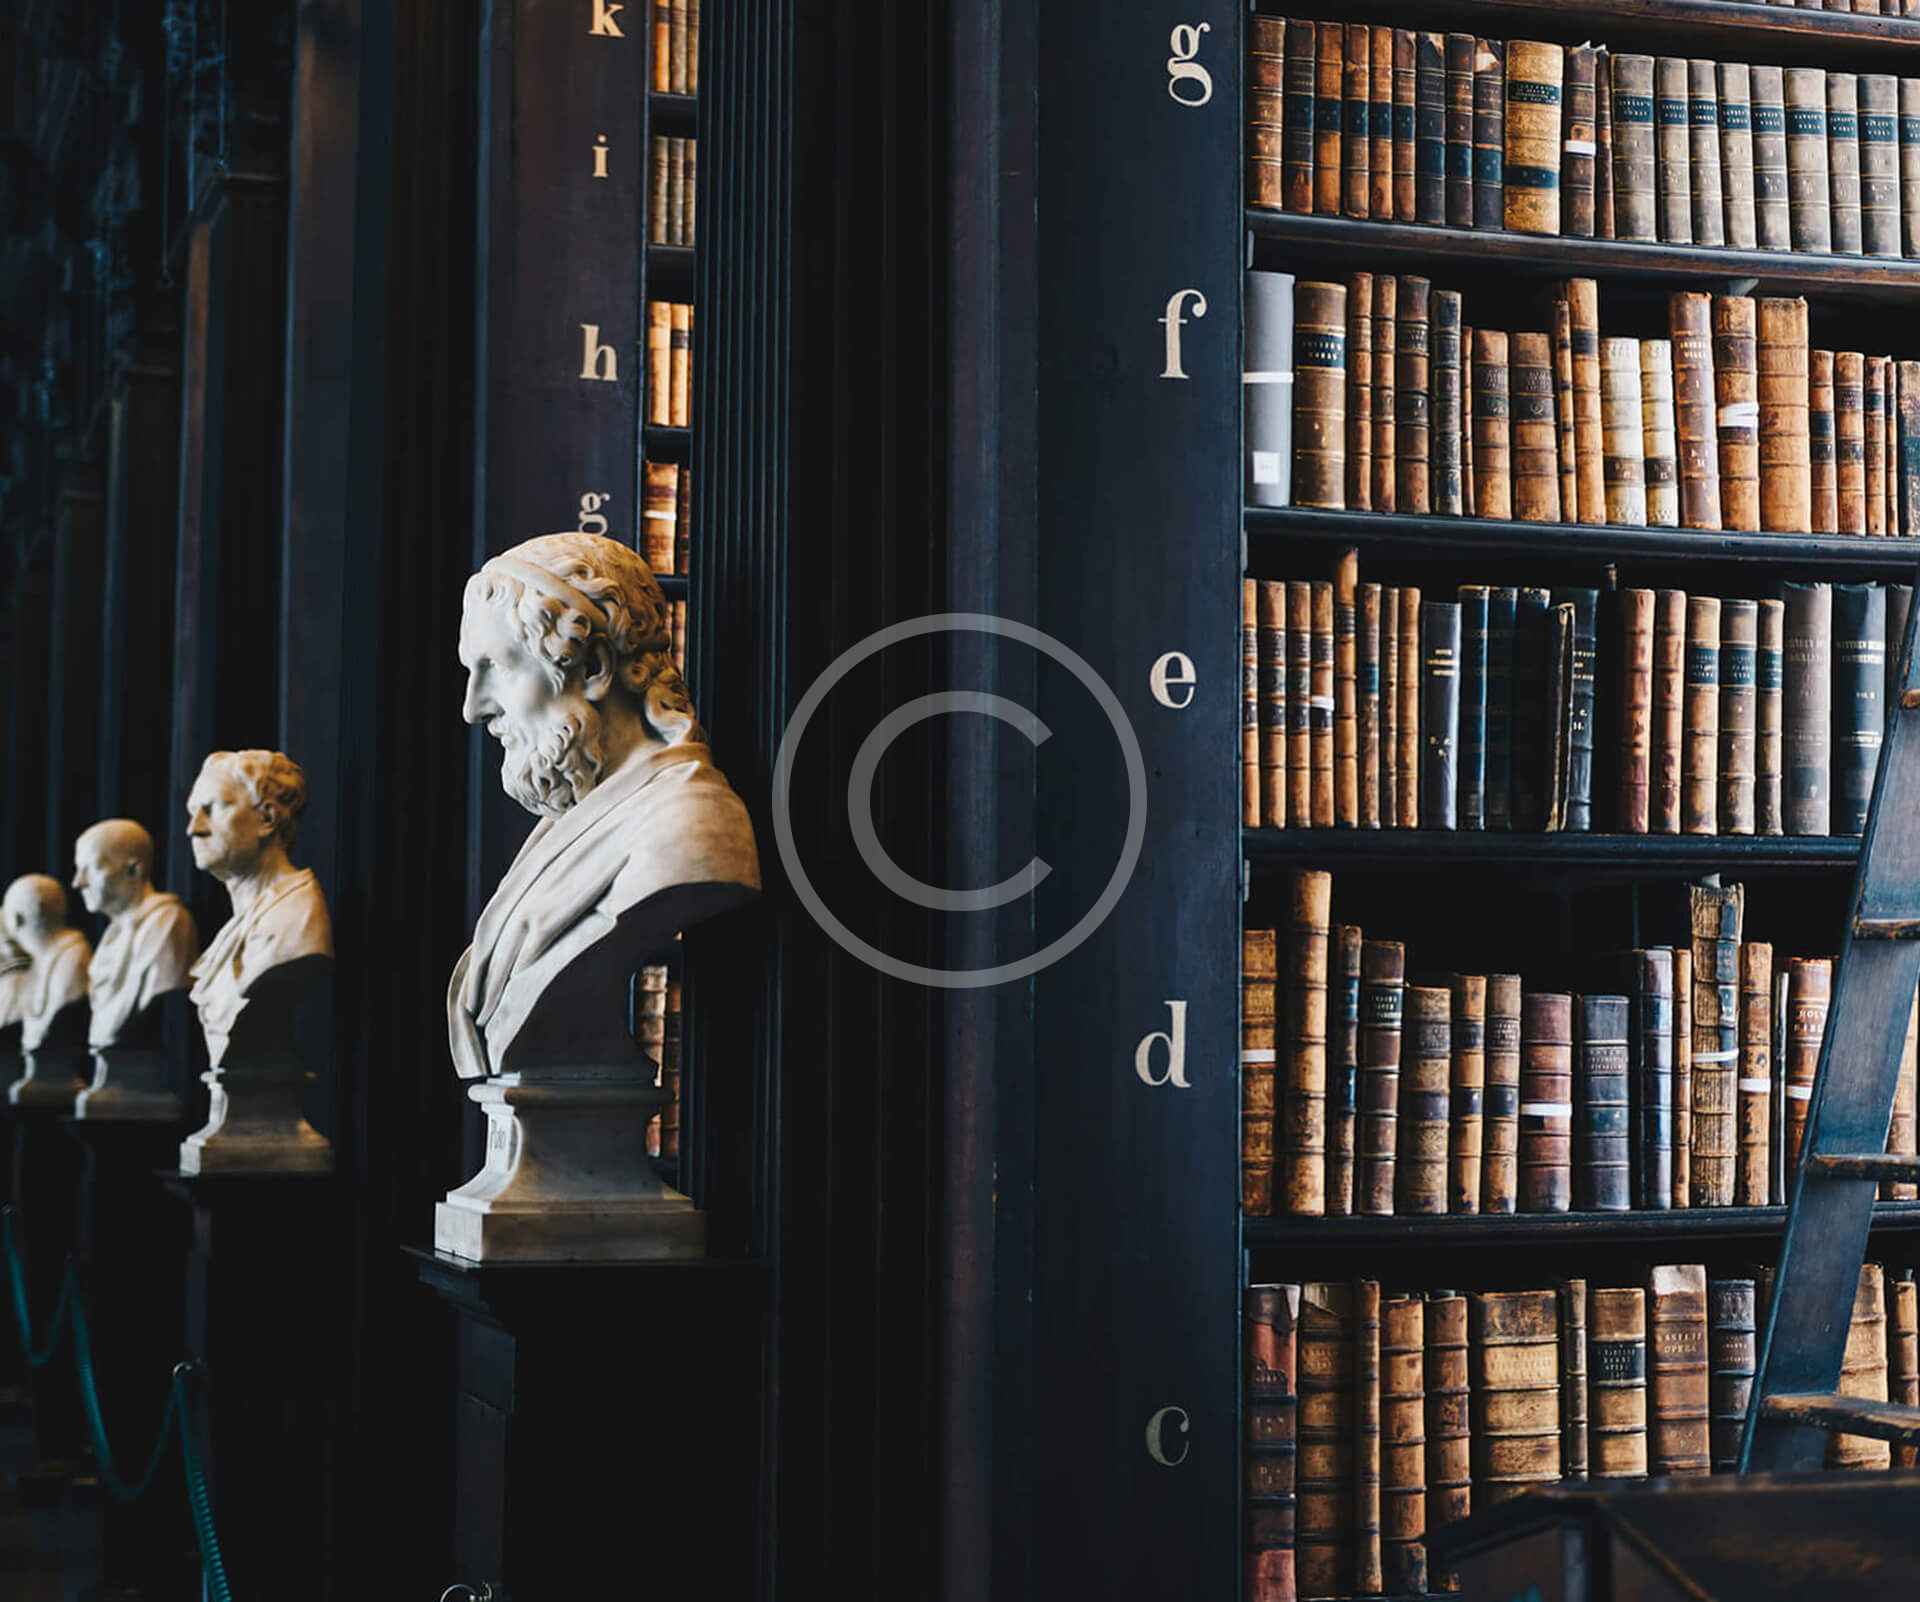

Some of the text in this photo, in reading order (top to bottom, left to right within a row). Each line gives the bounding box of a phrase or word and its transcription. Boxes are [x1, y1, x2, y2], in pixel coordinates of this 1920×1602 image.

[588, 0, 625, 38] k
[1167, 22, 1213, 107] g
[592, 134, 609, 178] i
[579, 323, 618, 382] h
[1157, 288, 1208, 380] f
[578, 492, 611, 535] g
[1149, 651, 1197, 709] e
[1135, 999, 1191, 1088] d
[1145, 1405, 1190, 1467] c
